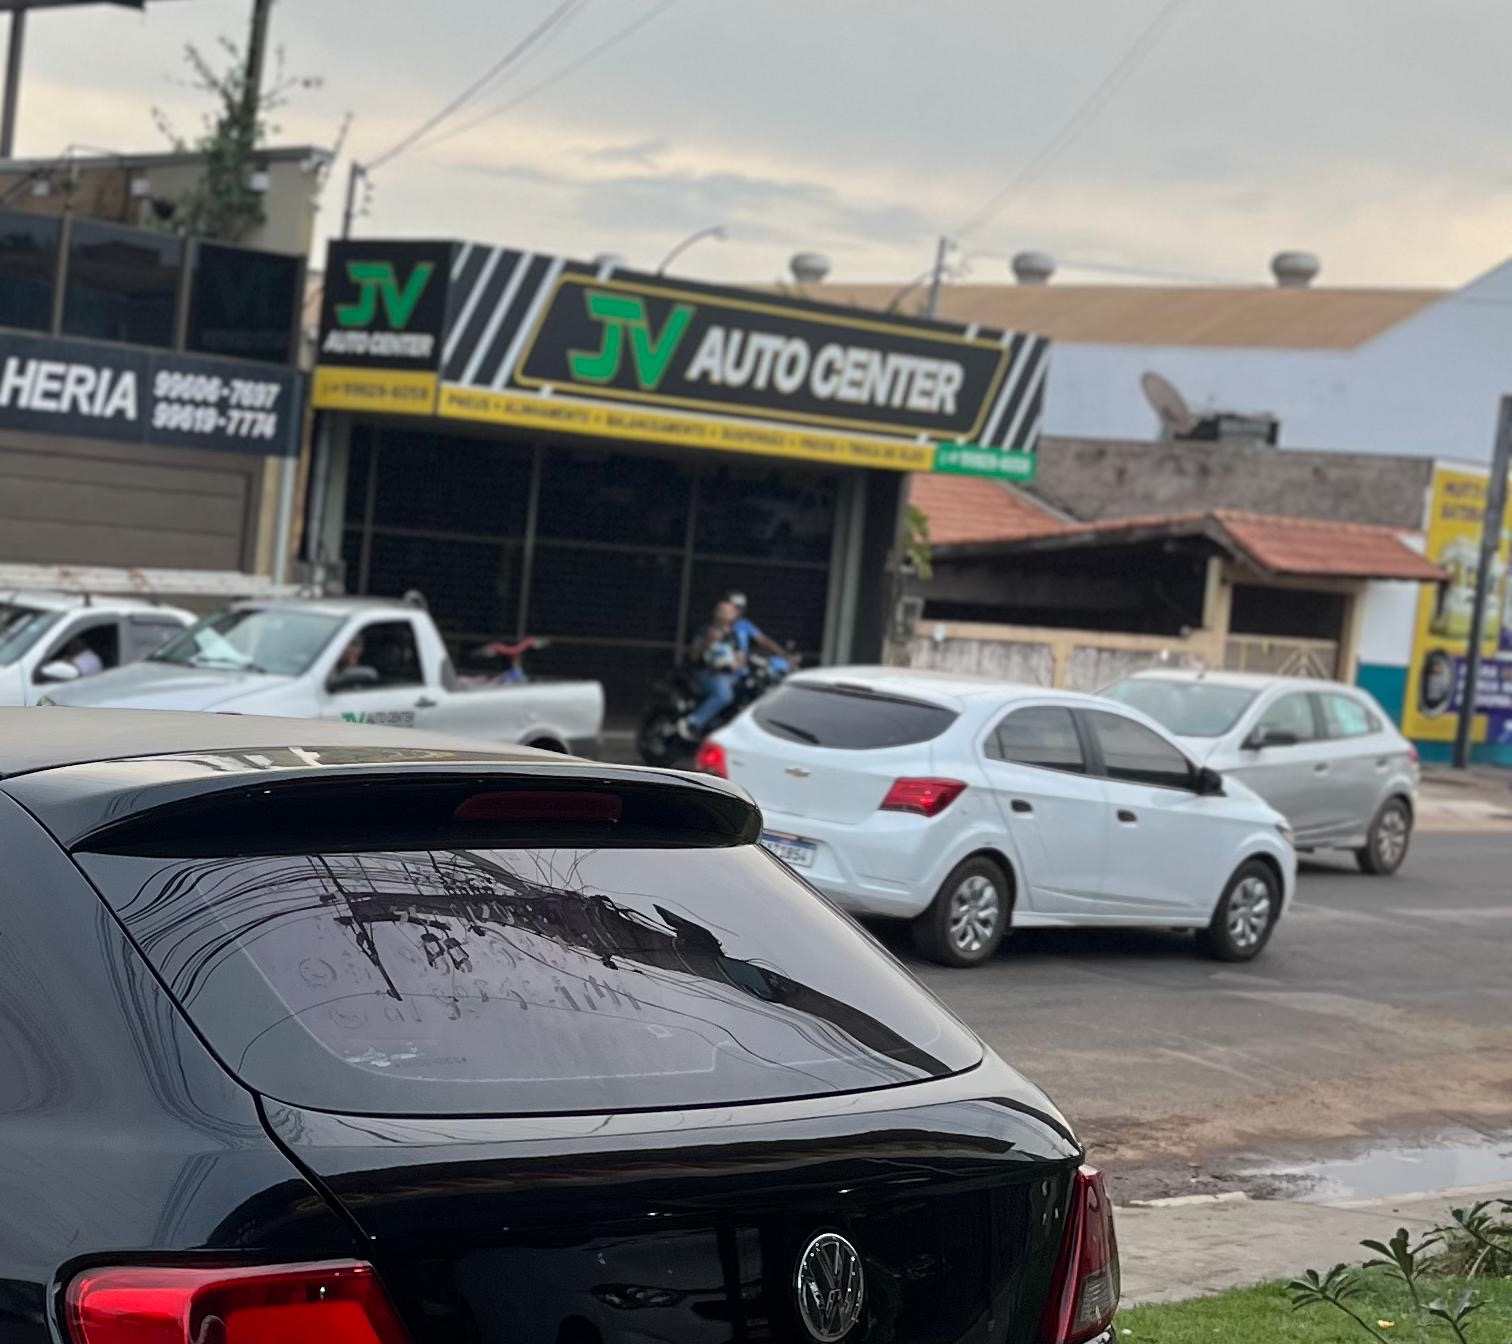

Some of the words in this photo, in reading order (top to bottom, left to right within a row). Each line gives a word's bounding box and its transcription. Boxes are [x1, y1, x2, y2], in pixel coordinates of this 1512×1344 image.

[335, 261, 435, 329] JV
[567, 289, 695, 390] JV
[685, 324, 810, 398] AUTO
[810, 341, 965, 416] CENTER
